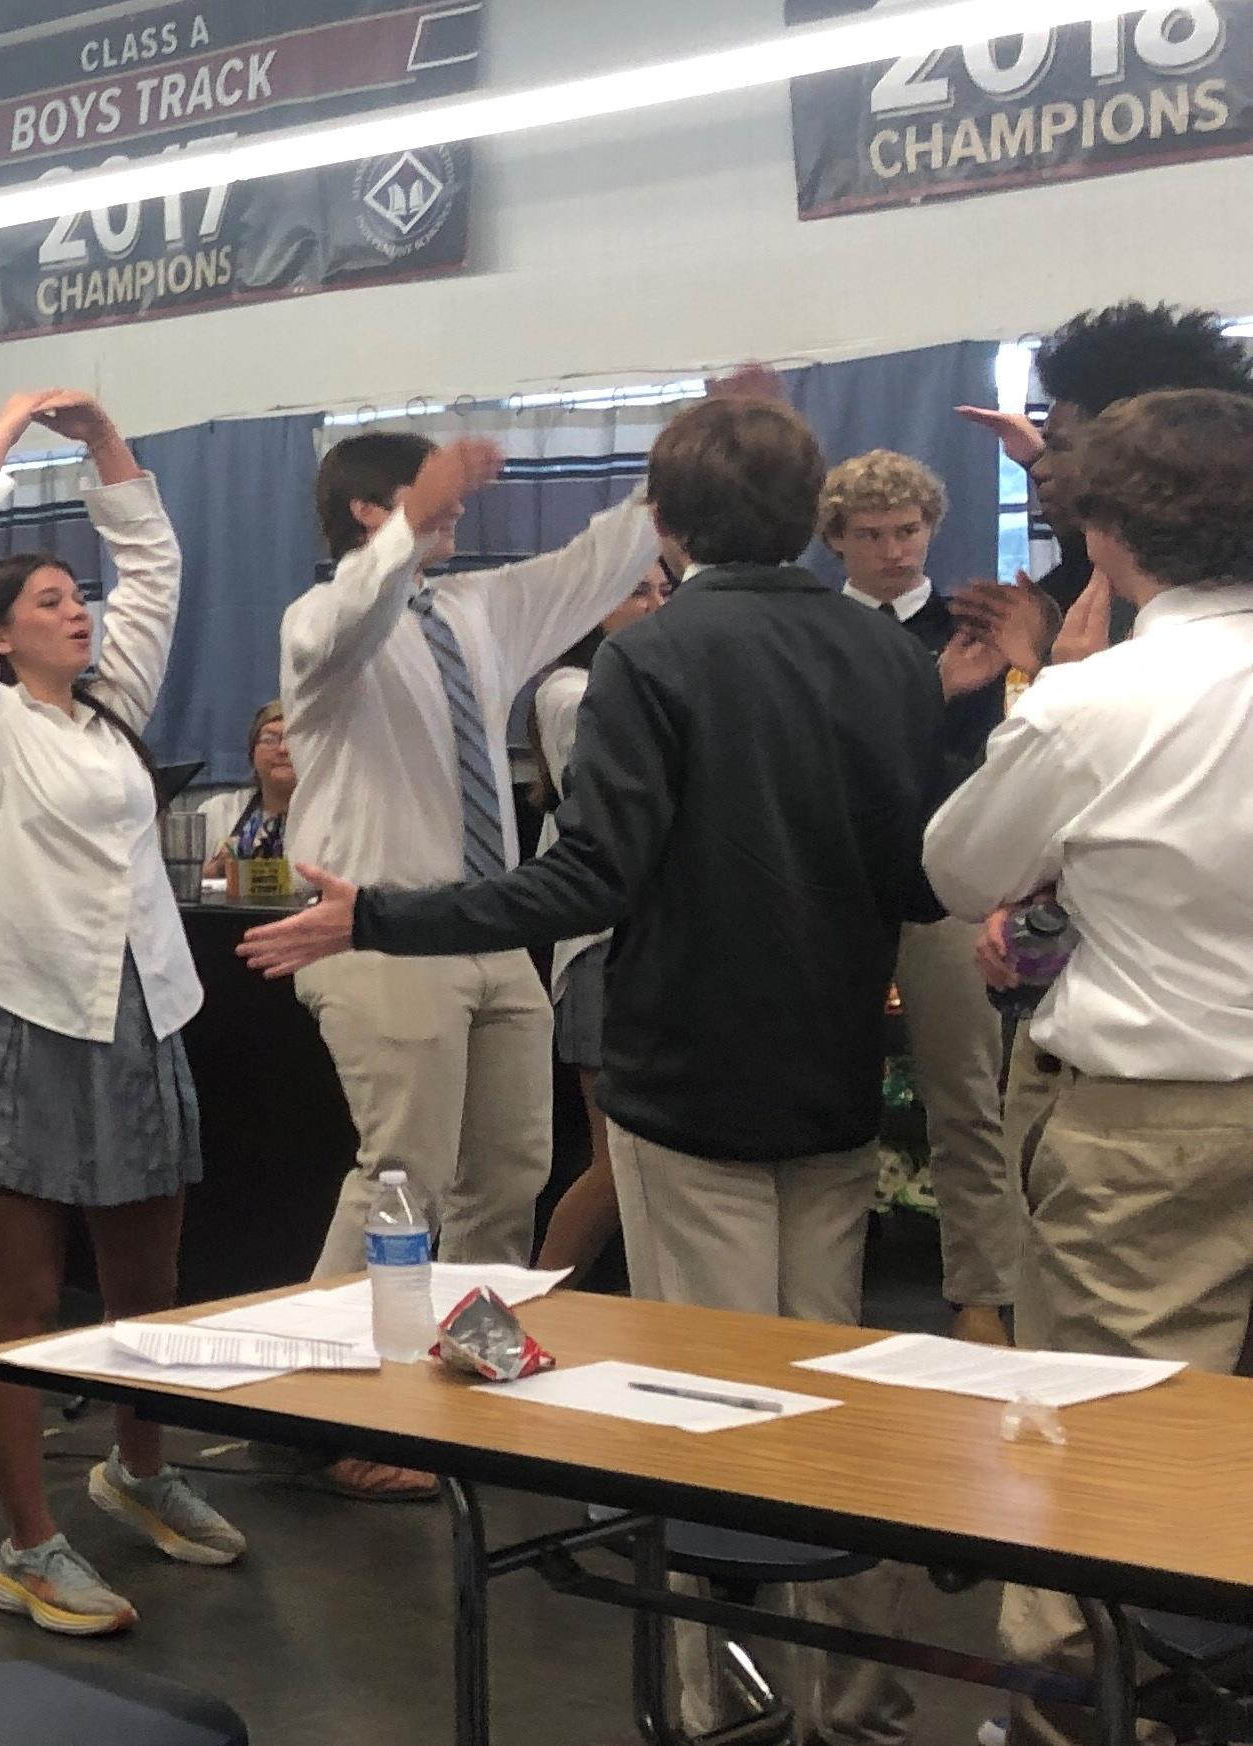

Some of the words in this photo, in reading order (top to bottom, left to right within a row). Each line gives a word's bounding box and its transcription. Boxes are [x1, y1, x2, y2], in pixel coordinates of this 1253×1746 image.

[80, 22, 178, 72] CLASS
[191, 15, 210, 48] A
[10, 87, 122, 152] BOYS
[137, 50, 277, 125] TRACK
[869, 78, 1230, 179] CHAMPIONS
[36, 245, 232, 315] CHAMPIONS
